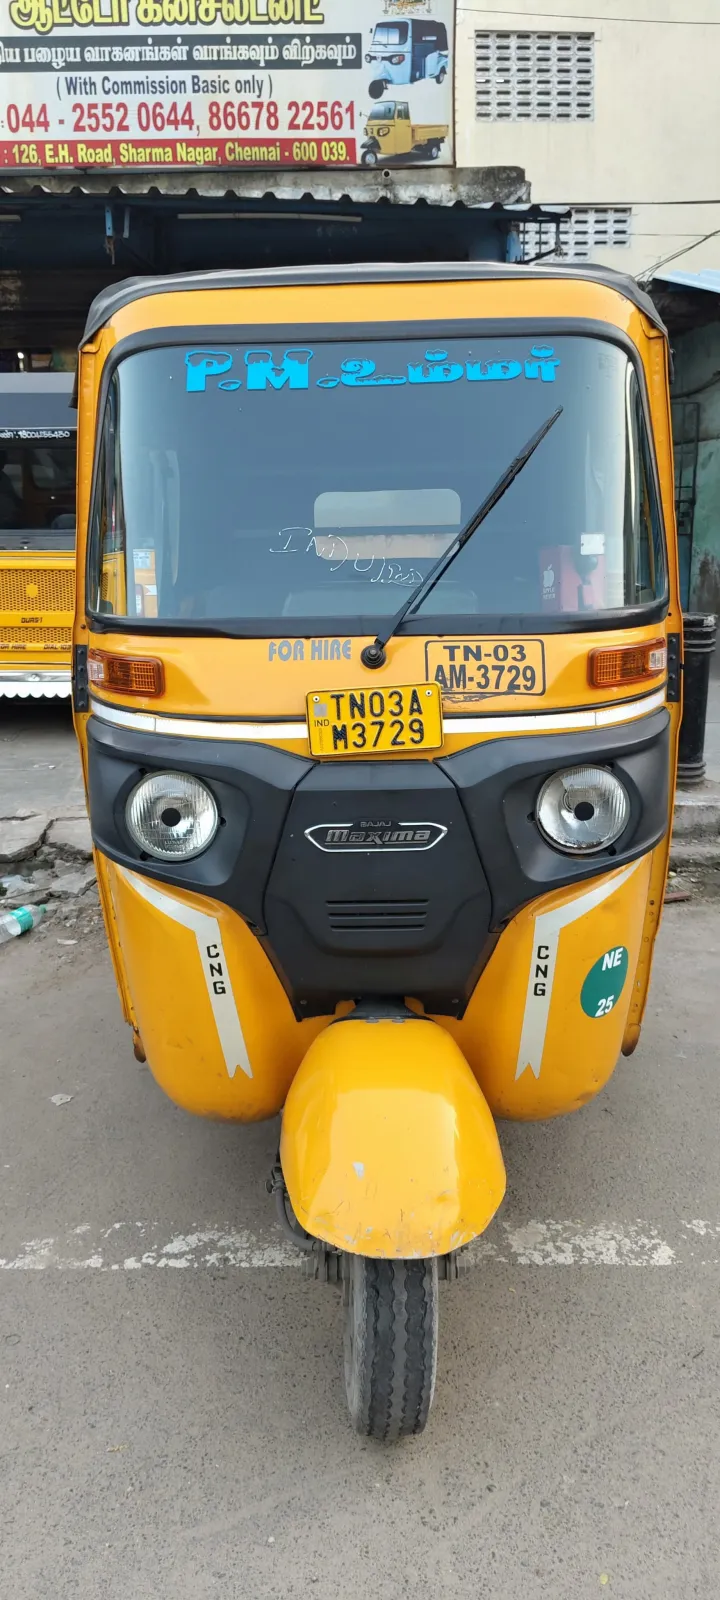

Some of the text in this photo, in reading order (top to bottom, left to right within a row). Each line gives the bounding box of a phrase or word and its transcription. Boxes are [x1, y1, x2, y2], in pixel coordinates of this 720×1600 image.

[24, 46, 81, 69] பழைய
[84, 37, 188, 62] வாகனங்கள்
[192, 36, 280, 67] வாங்கவும்
[282, 35, 357, 67] விற்கவும்
[65, 77, 97, 95] With
[101, 75, 187, 95] Commission
[191, 74, 230, 94] Basic
[235, 74, 264, 98] only
[7, 103, 50, 133] 044
[72, 102, 130, 132] 2552
[137, 101, 201, 136] 0644,
[208, 100, 279, 131] 86678
[287, 100, 355, 131] 22561
[12, 144, 42, 165] 126,
[45, 144, 74, 163] E.H.
[77, 143, 116, 165] Road,
[119, 142, 173, 162] Sharma
[176, 142, 222, 165] Nagar,
[225, 141, 281, 162] Chennai
[292, 142, 319, 161] 600
[322, 141, 350, 161] 039.
[268, 638, 352, 662] FOR HIRE
[442, 644, 527, 662] TN-03
[433, 664, 536, 692] AM-3729
[330, 687, 424, 720] TN03A
[313, 719, 330, 727] IND
[331, 717, 425, 750] M3729
[360, 820, 392, 828] BAJAJ
[206, 944, 226, 995] CNG
[533, 945, 550, 997] CNG
[601, 947, 624, 971] NE
[594, 994, 615, 1018] 25
